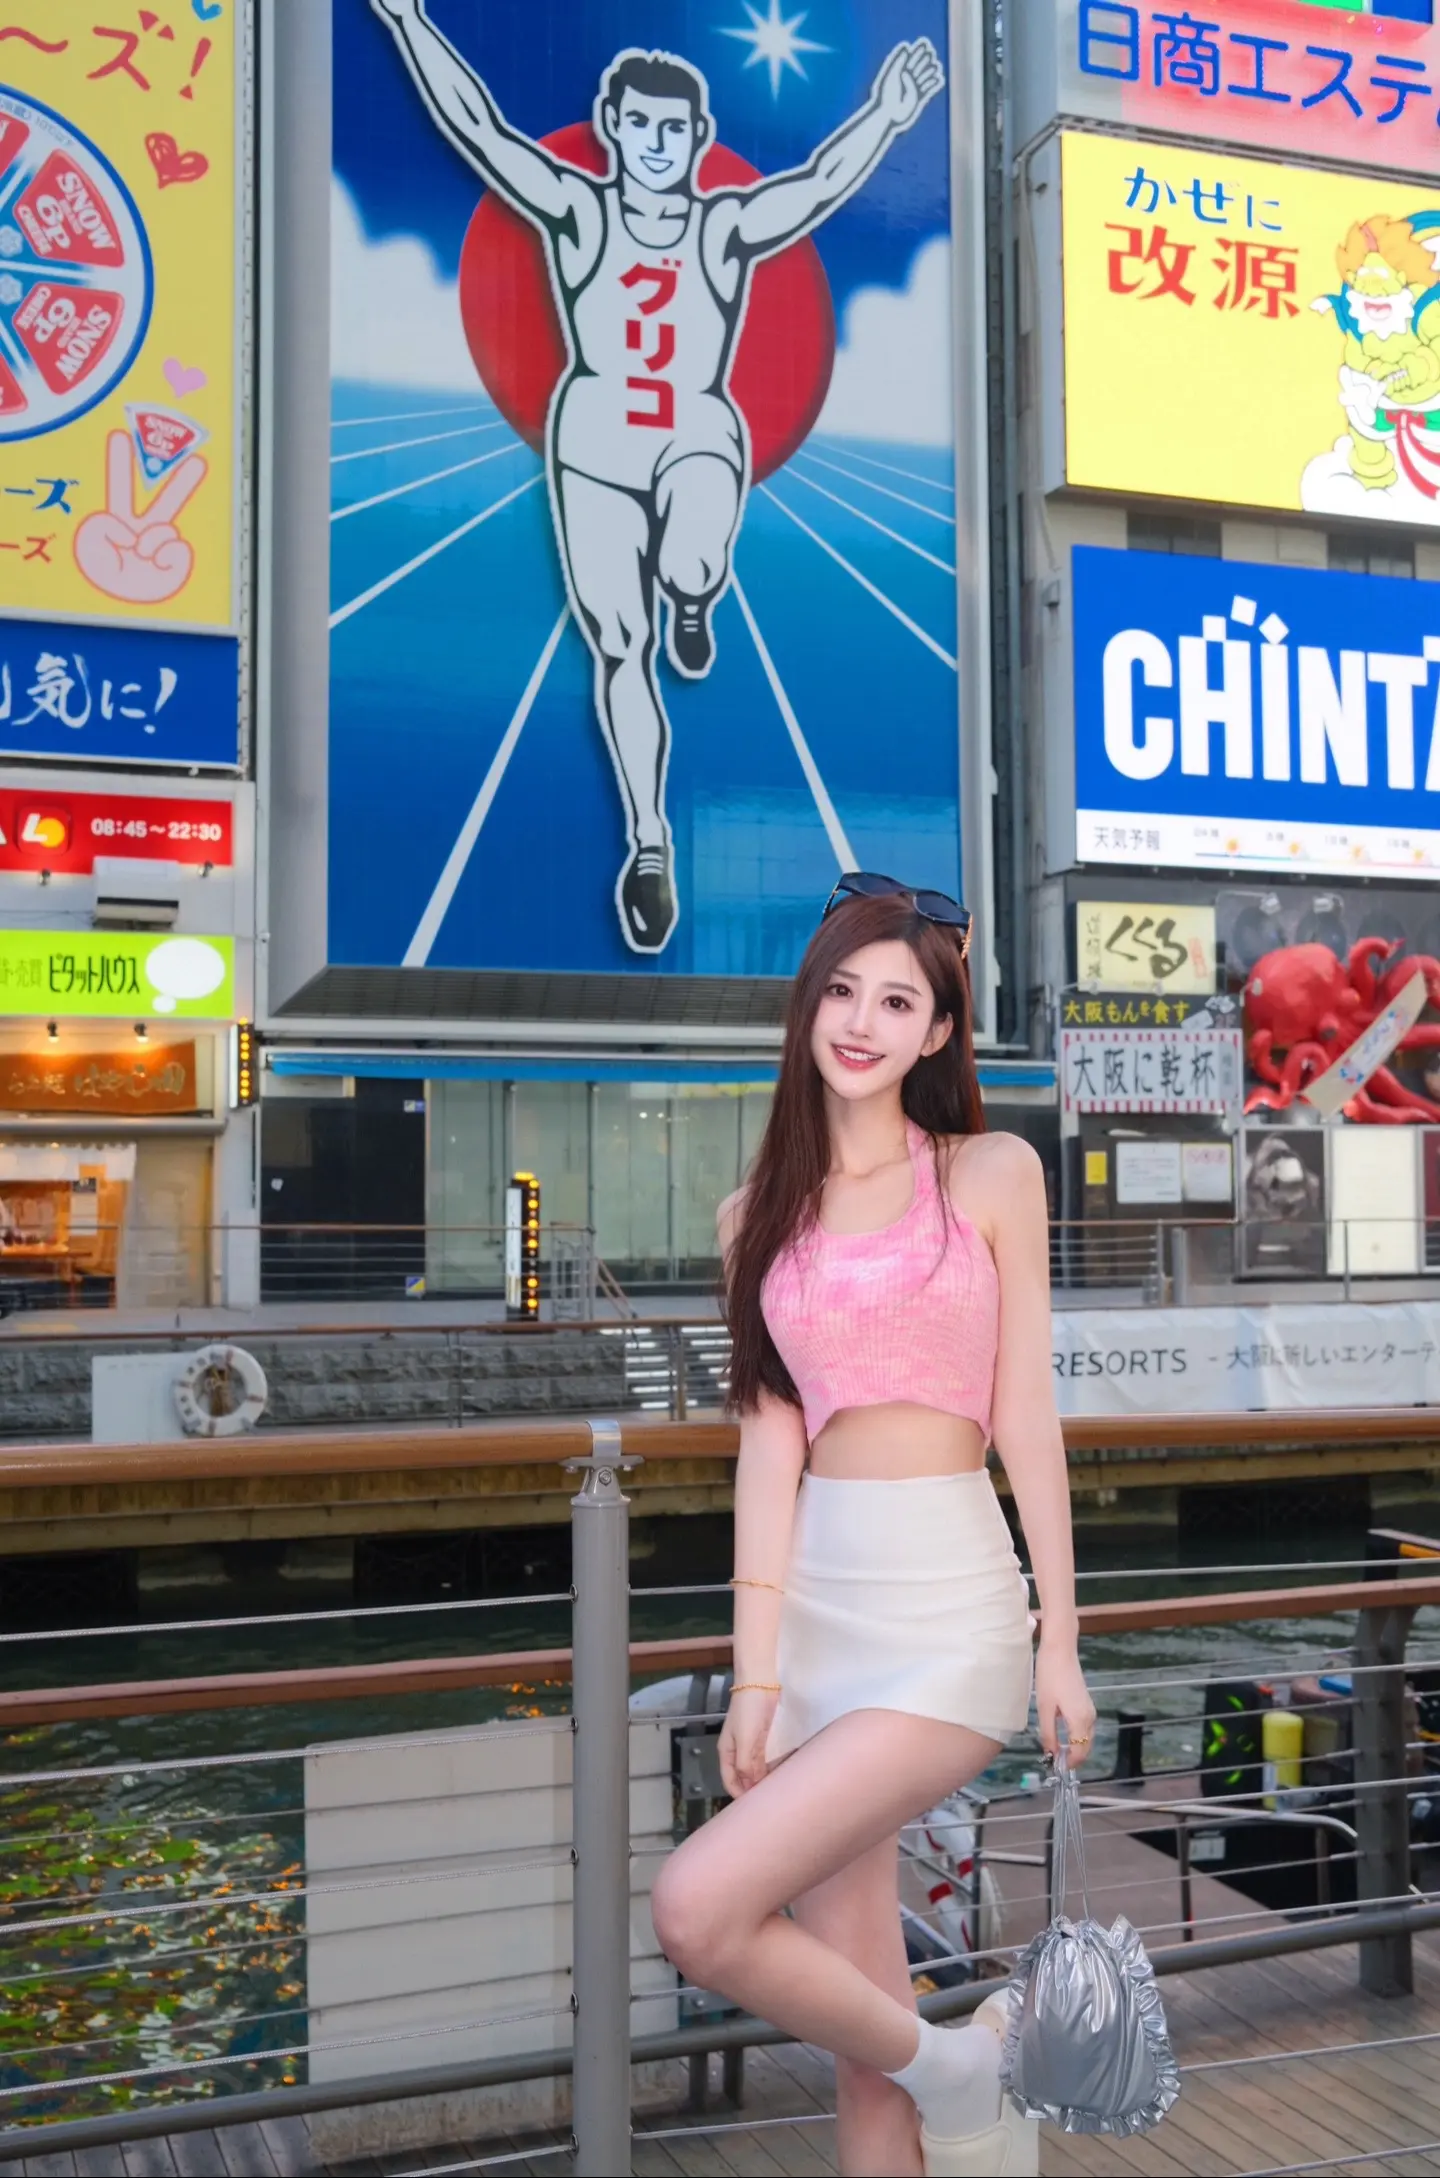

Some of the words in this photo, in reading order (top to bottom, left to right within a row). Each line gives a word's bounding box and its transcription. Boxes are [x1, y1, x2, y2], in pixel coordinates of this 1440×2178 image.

[1079, 0, 1440, 128] 日商エステ
[36, 194, 71, 249] 6P
[56, 171, 116, 249] SNOW
[1124, 167, 1283, 232] かぜに
[1104, 224, 1301, 319] 改源
[35, 298, 76, 343] 6P
[55, 304, 111, 382] SNOW
[618, 257, 682, 430] グリコ
[48, 953, 140, 994] ピタットハウス
[1105, 915, 1188, 978] くくる
[1073, 1044, 1216, 1098] 大阪に乾杯
[1052, 1348, 1187, 1377] RESORTS
